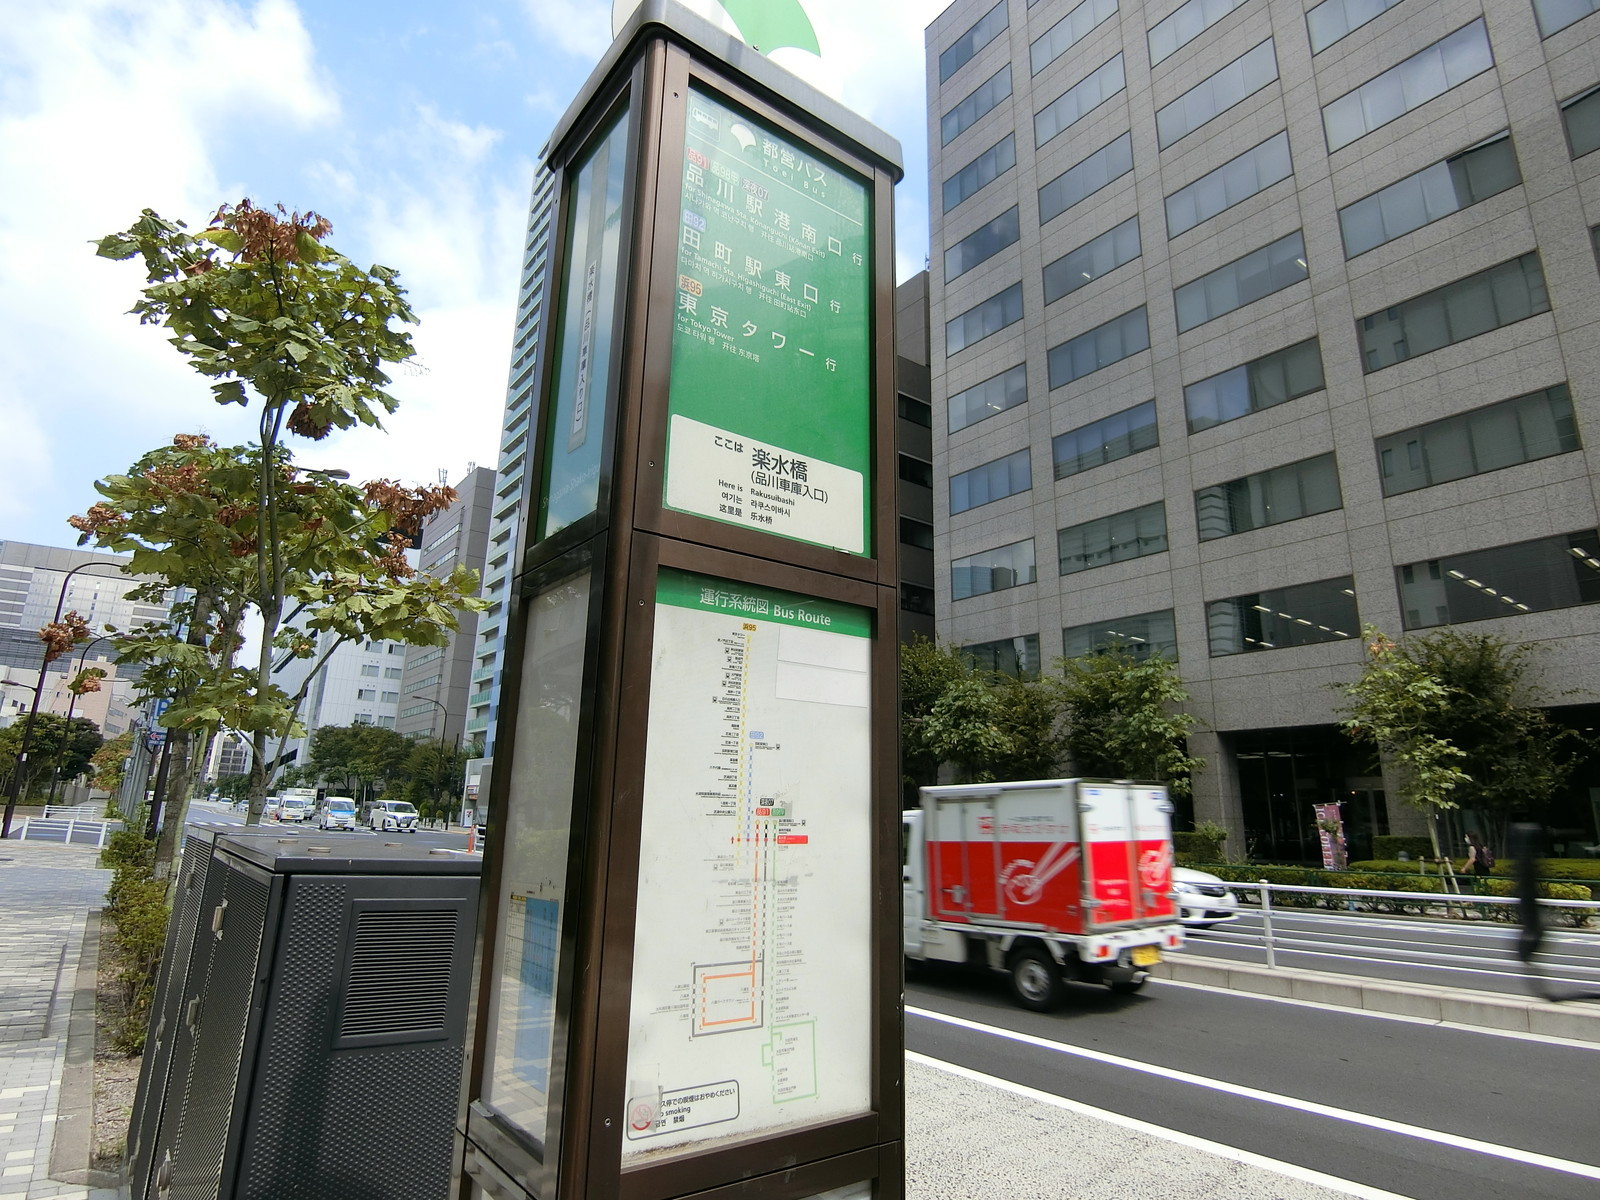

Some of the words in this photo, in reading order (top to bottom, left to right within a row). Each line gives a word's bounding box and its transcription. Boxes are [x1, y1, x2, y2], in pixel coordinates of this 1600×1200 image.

[688, 148, 707, 169] 品91
[762, 139, 827, 187] 都営バス
[764, 159, 794, 181] Toei
[803, 180, 825, 198] Bus
[685, 182, 696, 193] for
[698, 189, 735, 213] Shinagawa
[811, 245, 826, 259] Exit)
[681, 246, 692, 256] for
[694, 252, 722, 270] Tamachi
[723, 266, 736, 278] Sta.
[737, 273, 780, 297] Higashiguchi
[780, 291, 796, 305] (East
[797, 300, 812, 312] Exit)
[681, 276, 702, 295] 浜95
[677, 313, 688, 323] for
[690, 318, 711, 333] Tokyo
[712, 328, 735, 342] Tower
[714, 435, 744, 453] ここは
[752, 447, 808, 483] 楽水橋
[718, 479, 736, 491] Here
[737, 483, 743, 492] is
[750, 488, 795, 506] Rakusuibashi
[751, 470, 829, 504] (品川車庫入口)
[719, 503, 743, 518] 这里是
[750, 511, 773, 525] 乐水桥
[721, 492, 743, 505] 여기는
[750, 500, 791, 518] 라쿠스이바시
[700, 587, 769, 615] 運行系統図
[773, 604, 795, 619] Bus
[797, 608, 832, 626] Route
[660, 1088, 736, 1107] ス停での喫煙はおやめください
[665, 1106, 691, 1116] smoking
